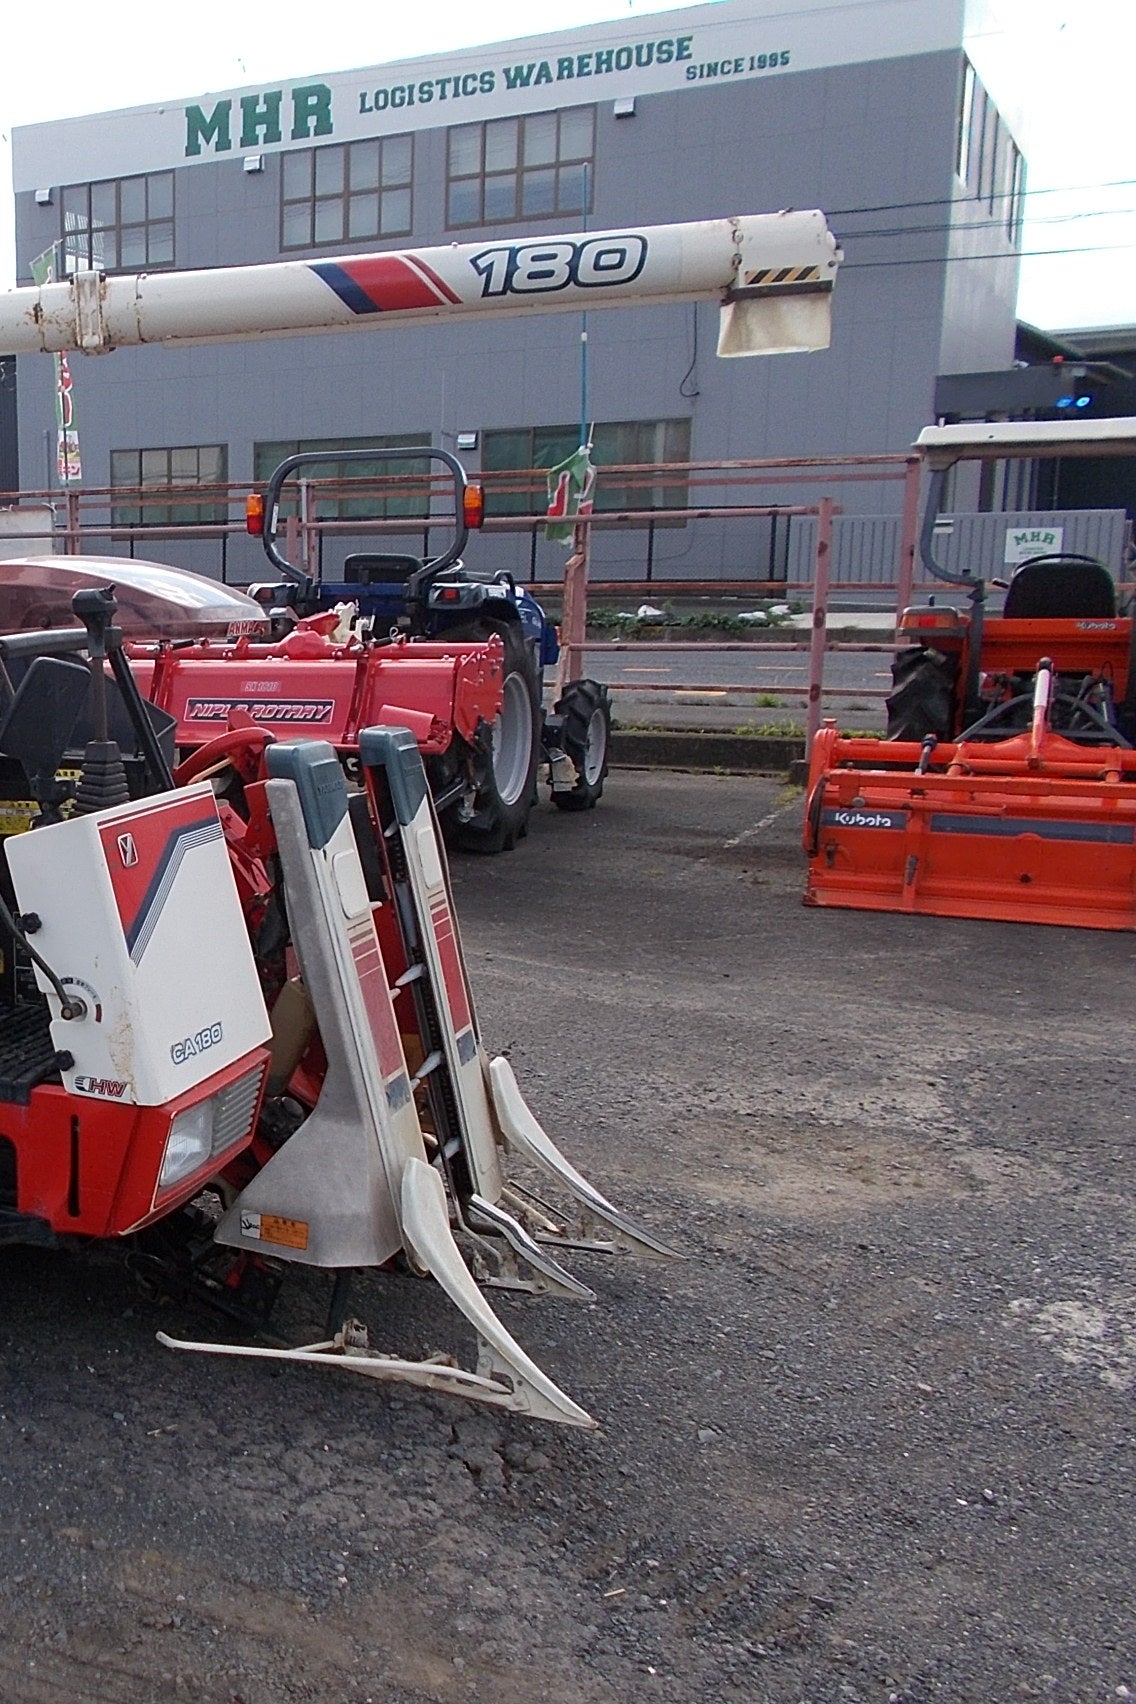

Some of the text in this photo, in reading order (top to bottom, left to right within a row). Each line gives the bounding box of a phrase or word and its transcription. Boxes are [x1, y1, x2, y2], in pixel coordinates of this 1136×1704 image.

[686, 58, 744, 80] SINCE
[185, 36, 693, 157] MHR LOGISTICS WAREHOUSE
[469, 234, 648, 298] 180
[250, 704, 332, 720] ROTARY
[835, 812, 892, 827] Kubota
